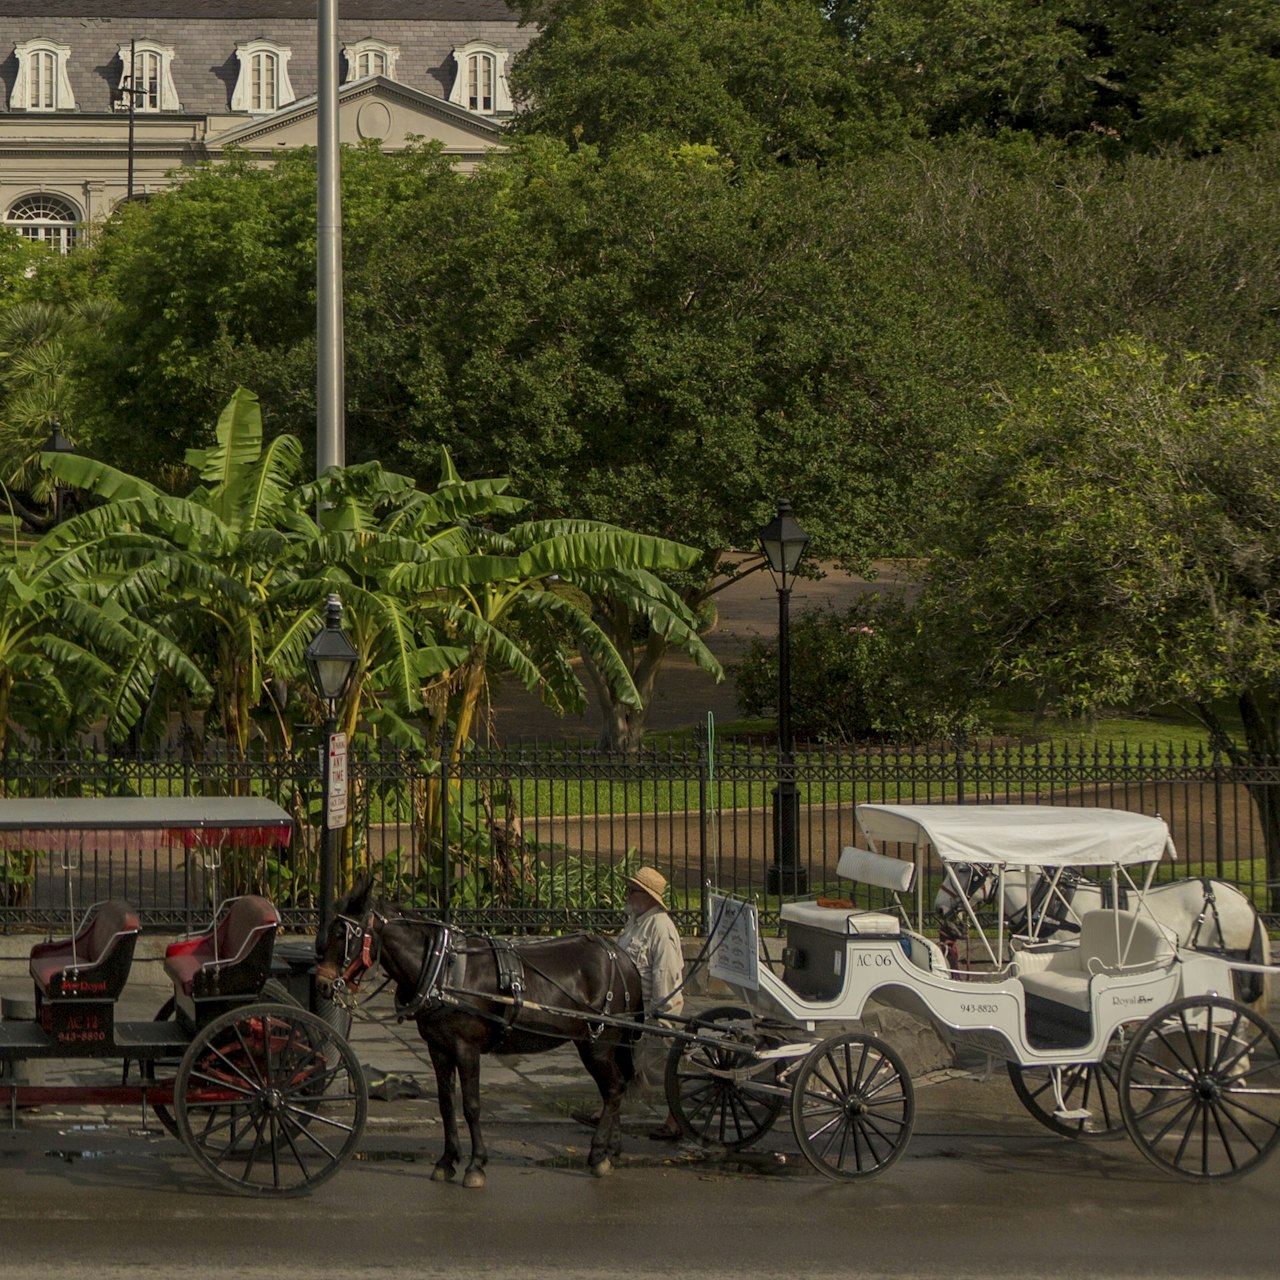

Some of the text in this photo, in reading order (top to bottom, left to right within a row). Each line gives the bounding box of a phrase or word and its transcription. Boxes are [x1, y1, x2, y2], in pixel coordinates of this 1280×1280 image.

[333, 756, 343, 769] ANY
[332, 770, 344, 783] TIME
[857, 954, 891, 967] AC 06
[80, 982, 107, 993] Royal
[1112, 995, 1136, 1008] Royal
[960, 1004, 999, 1014] 943-8820
